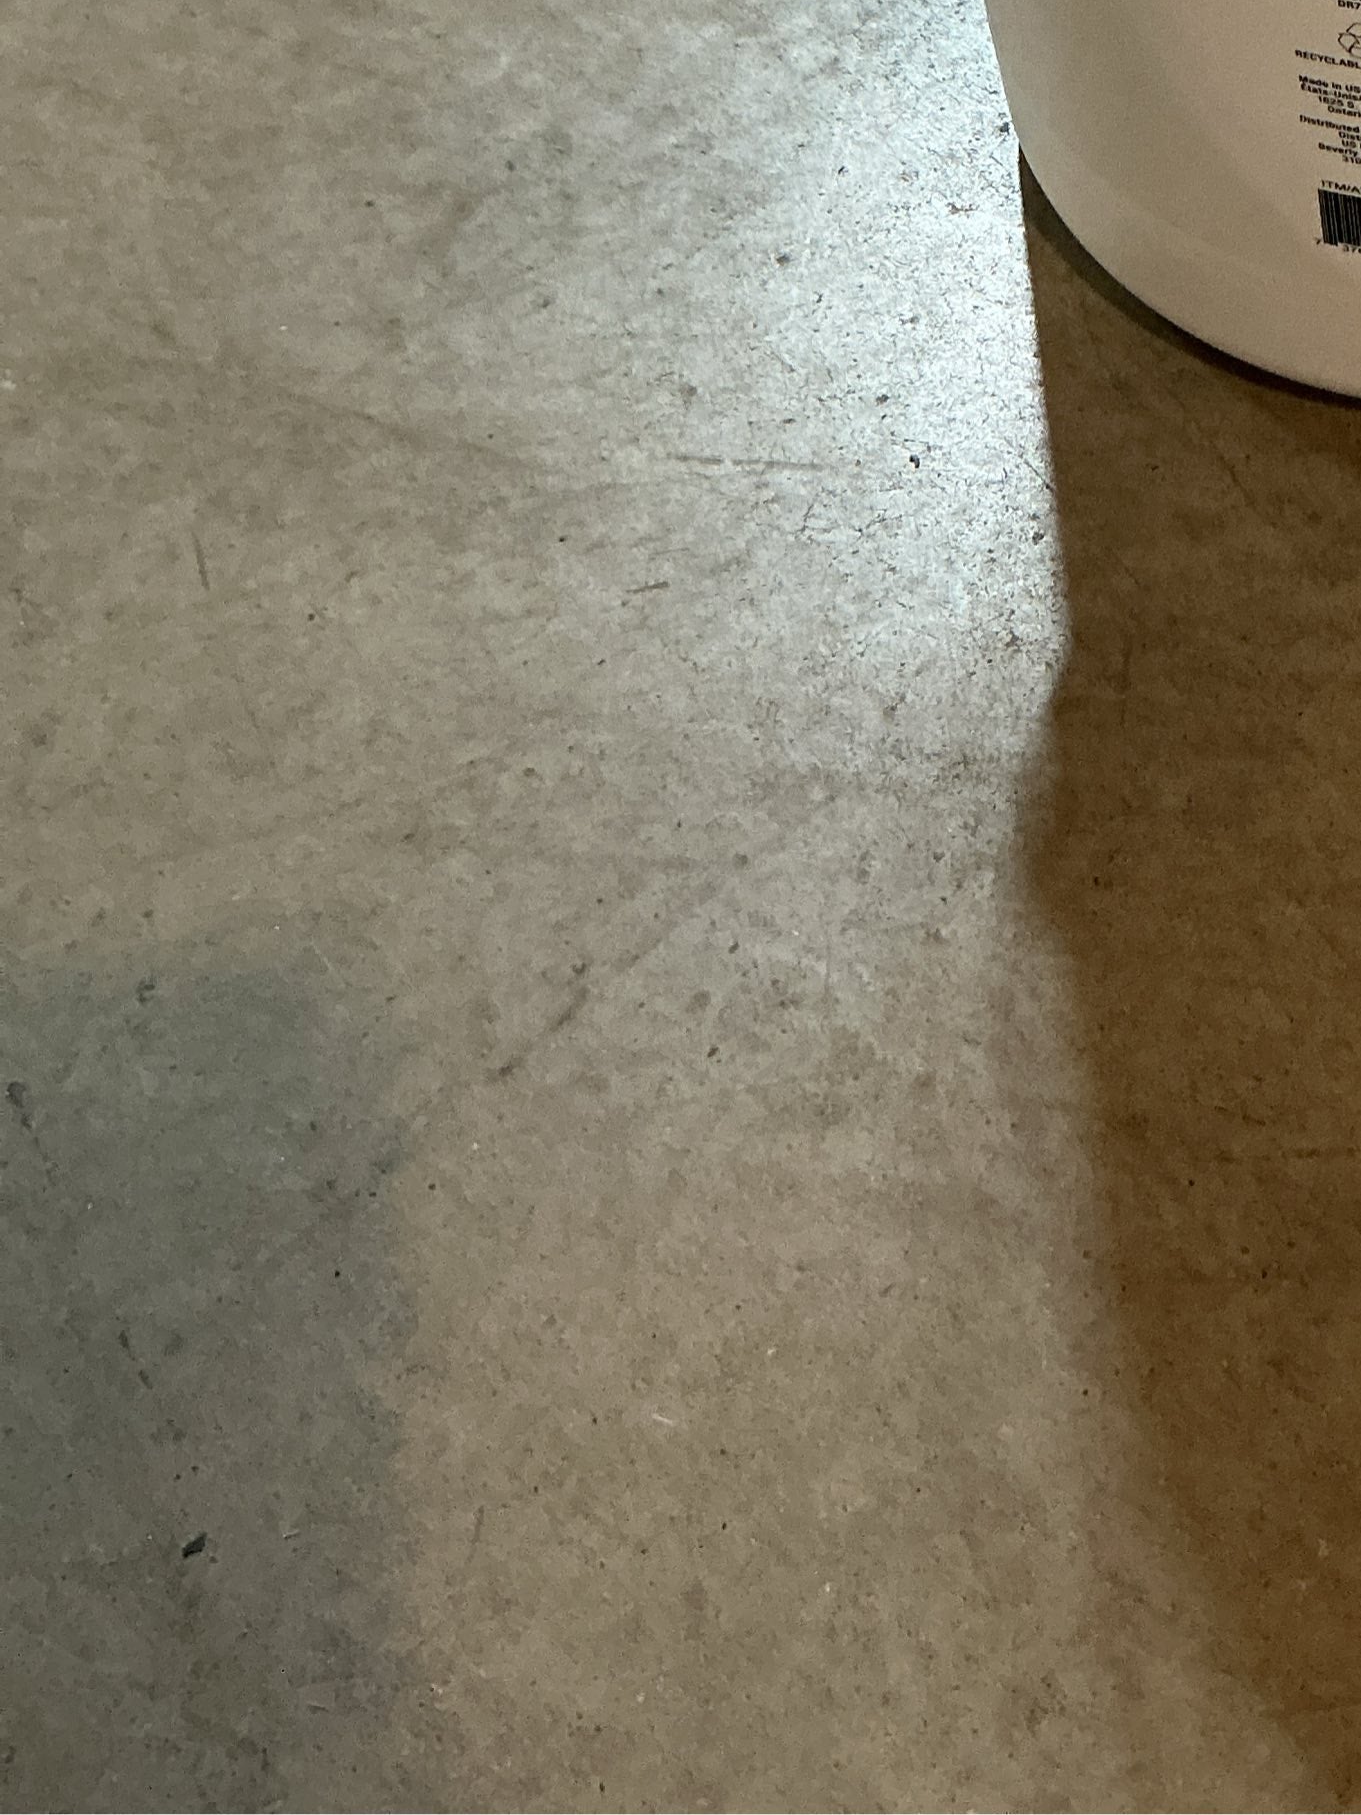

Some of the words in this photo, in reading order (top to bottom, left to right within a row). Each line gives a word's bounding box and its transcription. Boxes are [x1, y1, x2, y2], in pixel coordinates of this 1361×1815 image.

[1299, 75, 1328, 87] Made
[1332, 82, 1342, 90] in
[1300, 115, 1359, 133] Distributed
[1319, 143, 1358, 156] Beverly
[1342, 140, 1357, 149] US
